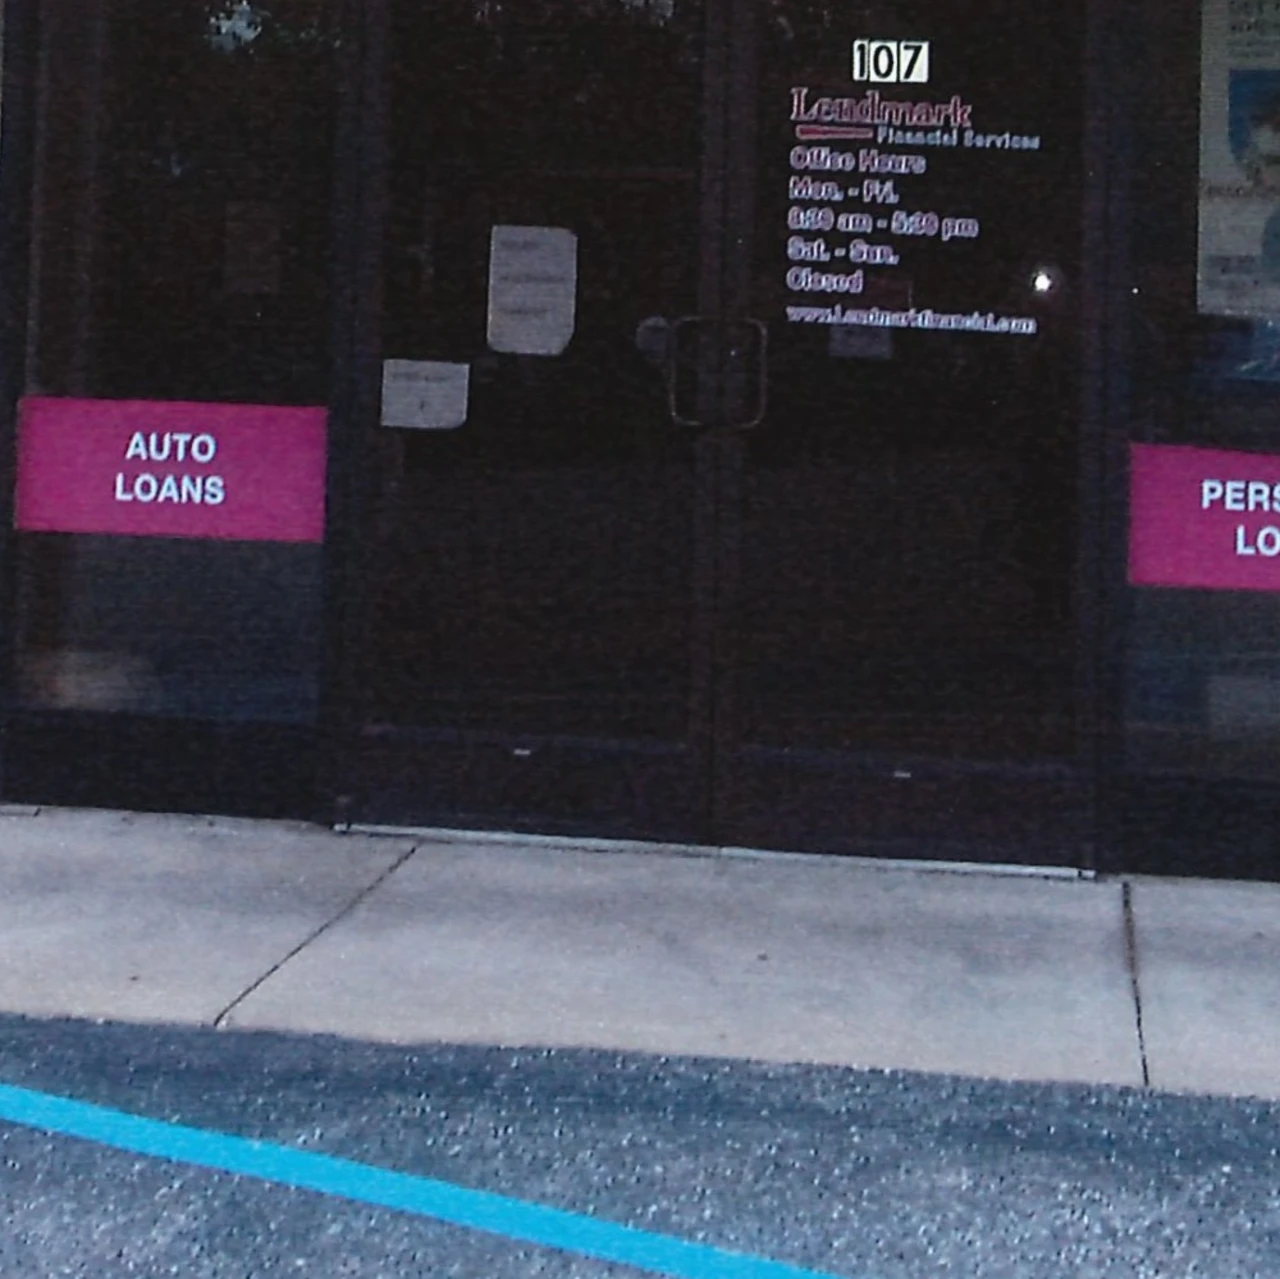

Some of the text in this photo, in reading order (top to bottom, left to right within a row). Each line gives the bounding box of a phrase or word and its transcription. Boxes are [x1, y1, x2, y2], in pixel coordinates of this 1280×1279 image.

[854, 40, 927, 81] 107
[790, 87, 972, 127] Lendmark
[877, 124, 1041, 150] Financial Services
[789, 145, 927, 174] Office Hours
[788, 175, 845, 202] Mon.
[837, 212, 874, 234] am
[941, 218, 980, 242] pm
[786, 235, 831, 262] Sat.
[848, 238, 900, 265] Sun.
[786, 266, 864, 293] Closed
[125, 431, 217, 463] AUTO
[115, 472, 226, 505] LOANS
